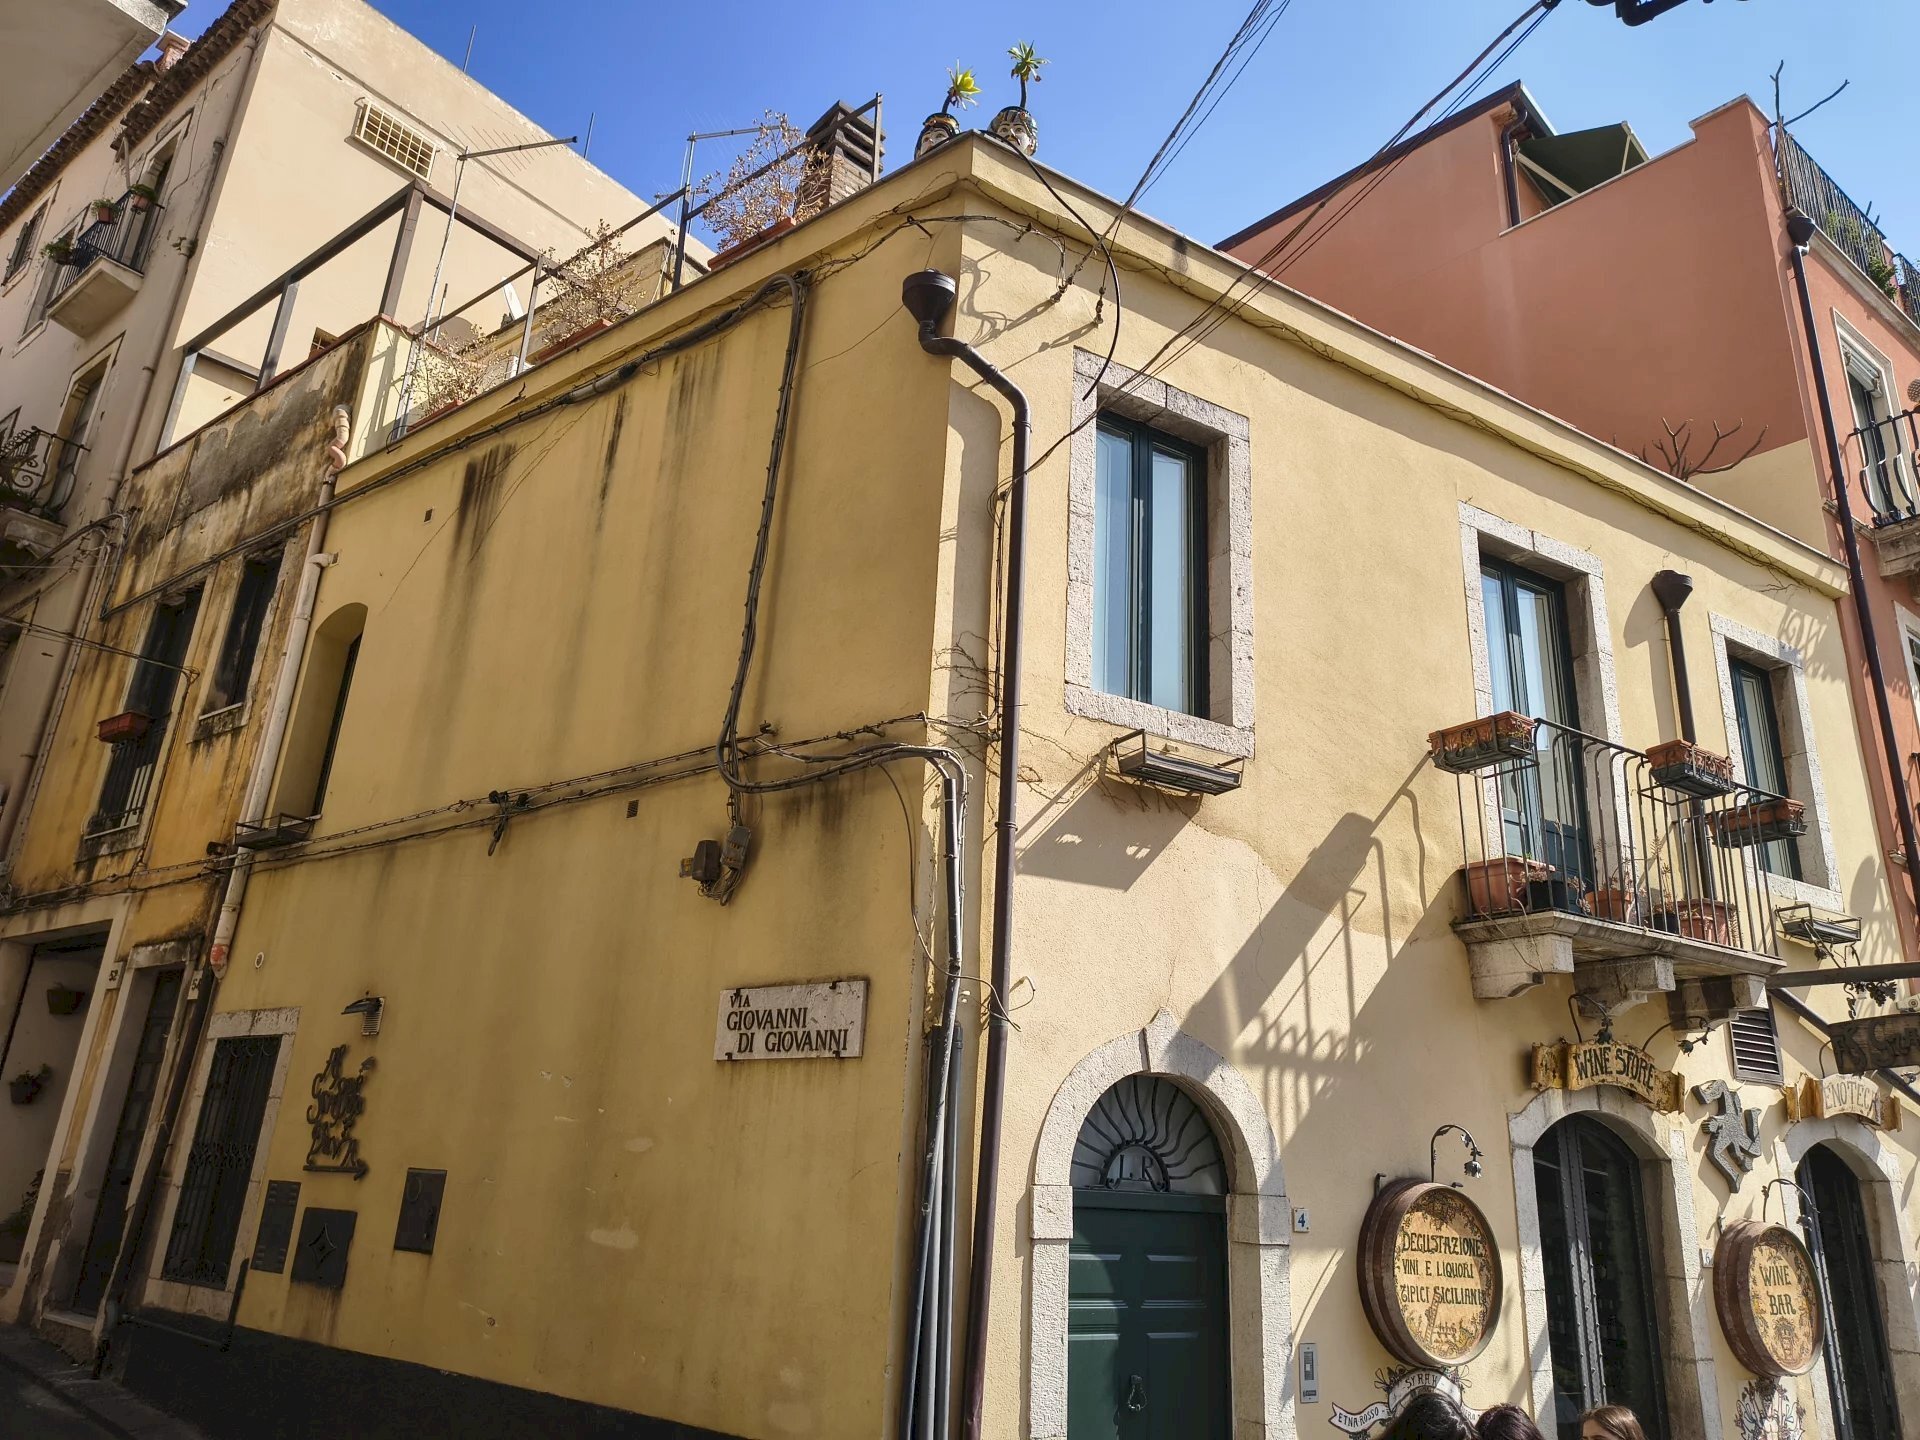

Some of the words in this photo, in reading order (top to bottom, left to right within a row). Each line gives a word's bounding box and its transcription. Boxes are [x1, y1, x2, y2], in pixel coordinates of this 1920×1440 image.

[108, 969, 119, 982] 52
[730, 994, 750, 1009] VIA
[726, 1007, 808, 1031] GIOVANNI
[737, 1032, 755, 1053] DI
[764, 1028, 849, 1053] GIOVANNI
[1573, 1046, 1613, 1081] WINE
[1615, 1049, 1656, 1091] STORE
[1824, 1080, 1879, 1122] ENOTECA
[1297, 1212, 1306, 1228] 4
[1401, 1231, 1483, 1258] DEGUSTAZIONE
[1401, 1258, 1419, 1275] VINI
[1425, 1260, 1432, 1276] E
[1436, 1261, 1474, 1279] LIQUORI
[1760, 1264, 1792, 1287] WINE
[1400, 1284, 1430, 1304] TIPICI
[1433, 1285, 1481, 1306] SICILIANI
[1767, 1291, 1796, 1316] BAR
